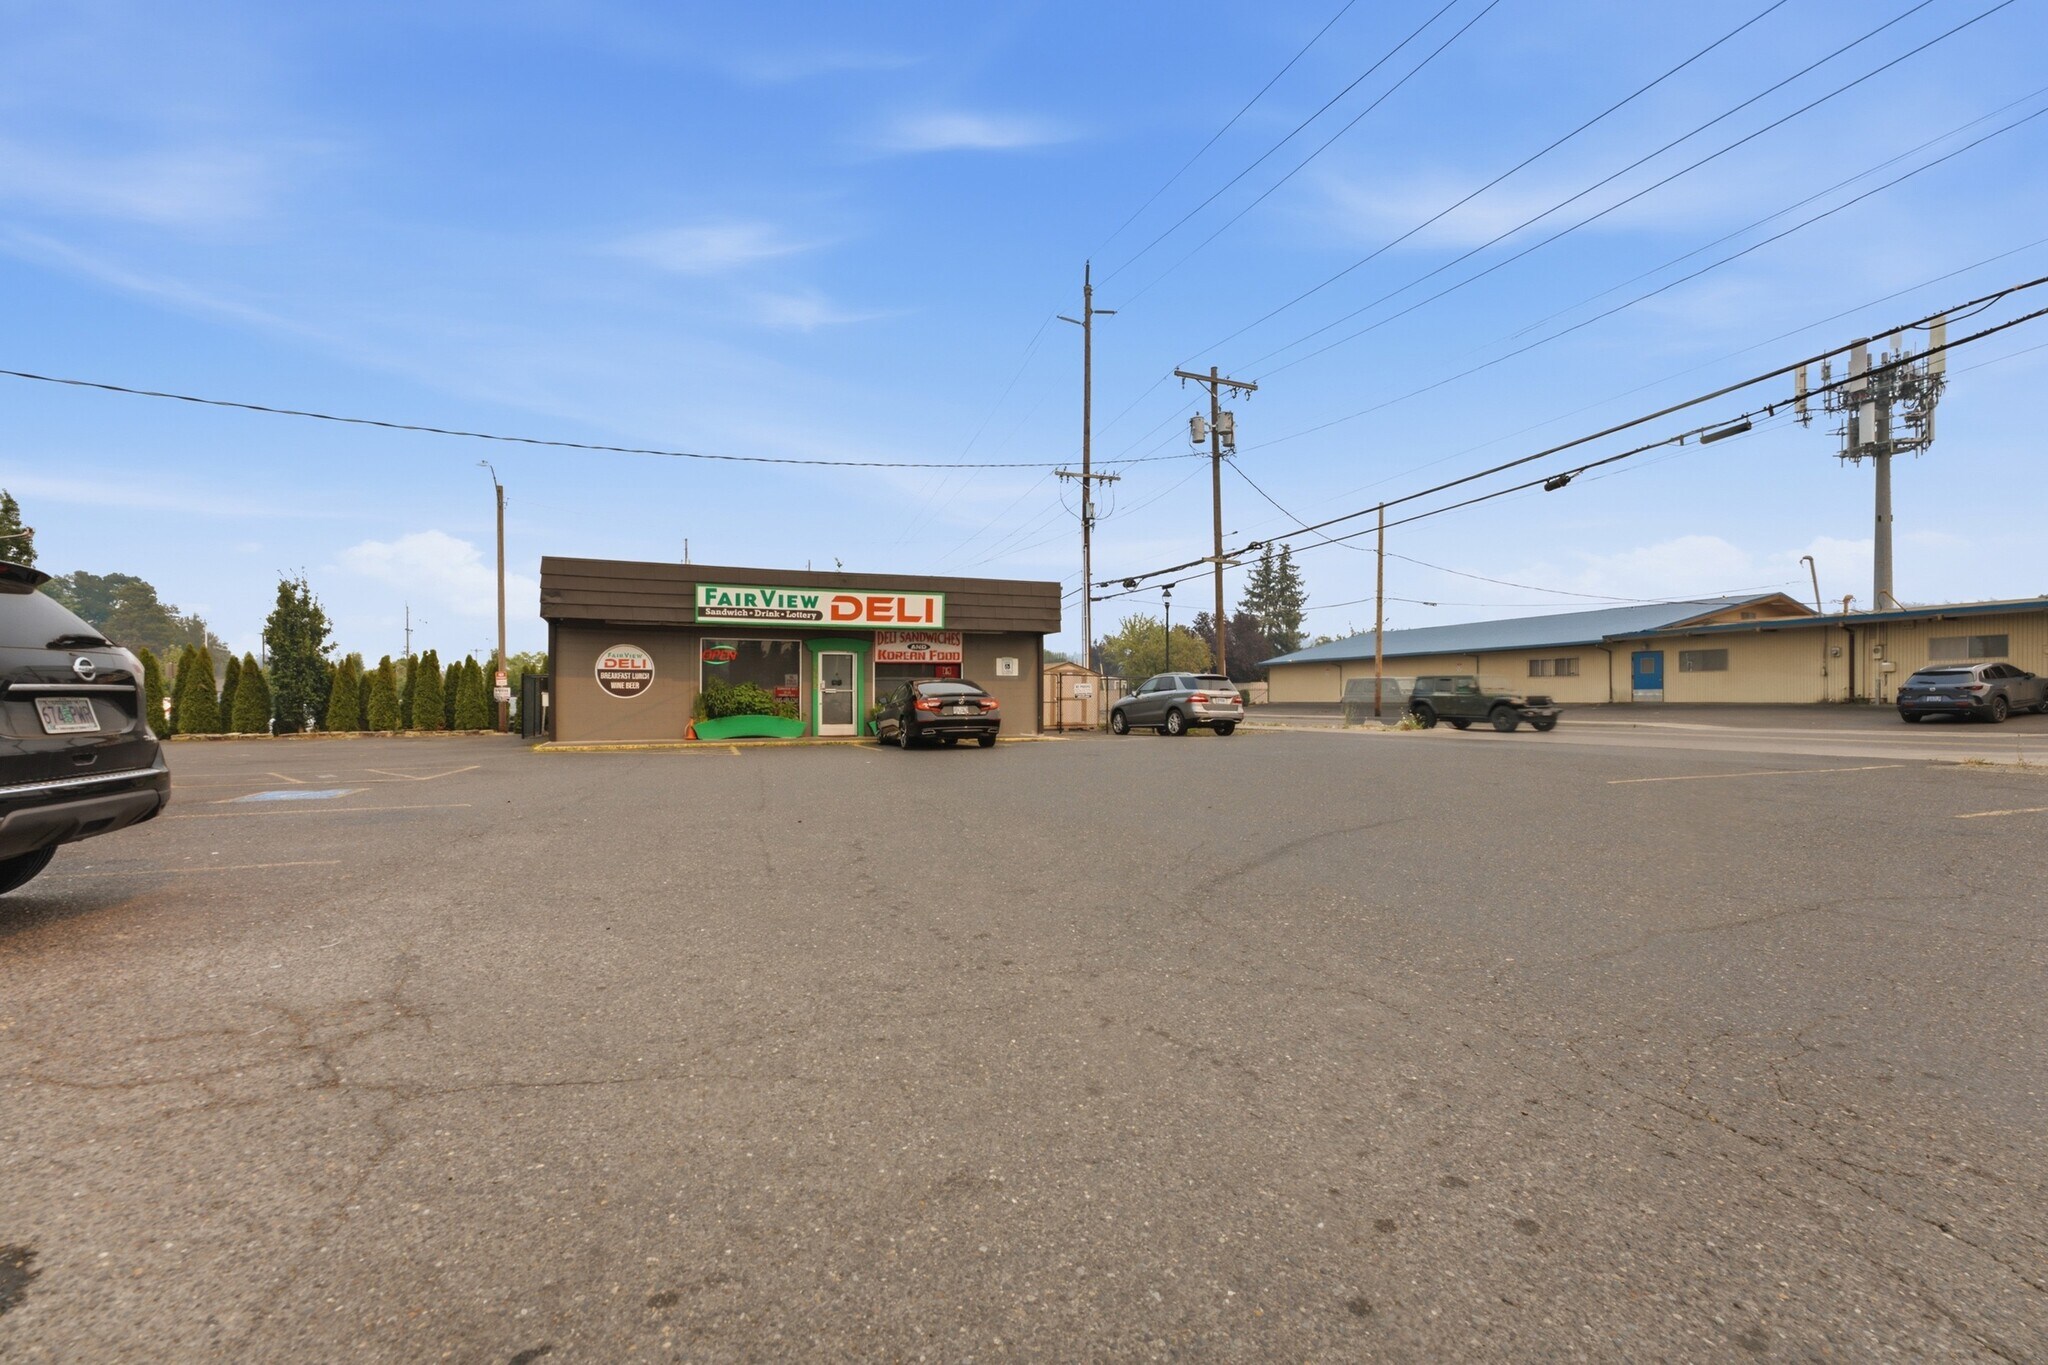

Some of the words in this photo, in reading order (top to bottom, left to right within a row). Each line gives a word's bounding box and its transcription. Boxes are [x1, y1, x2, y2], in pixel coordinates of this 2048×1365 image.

[705, 607, 748, 617] Sandwich
[754, 609, 780, 618] Drink
[786, 611, 817, 620] Lottery
[830, 595, 934, 623] DELI
[877, 630, 897, 645] DELI
[703, 649, 737, 660] OPEN
[604, 659, 646, 668] DELI
[610, 681, 625, 689] WINE
[626, 681, 640, 689] BEER
[42, 705, 64, 724] 674
